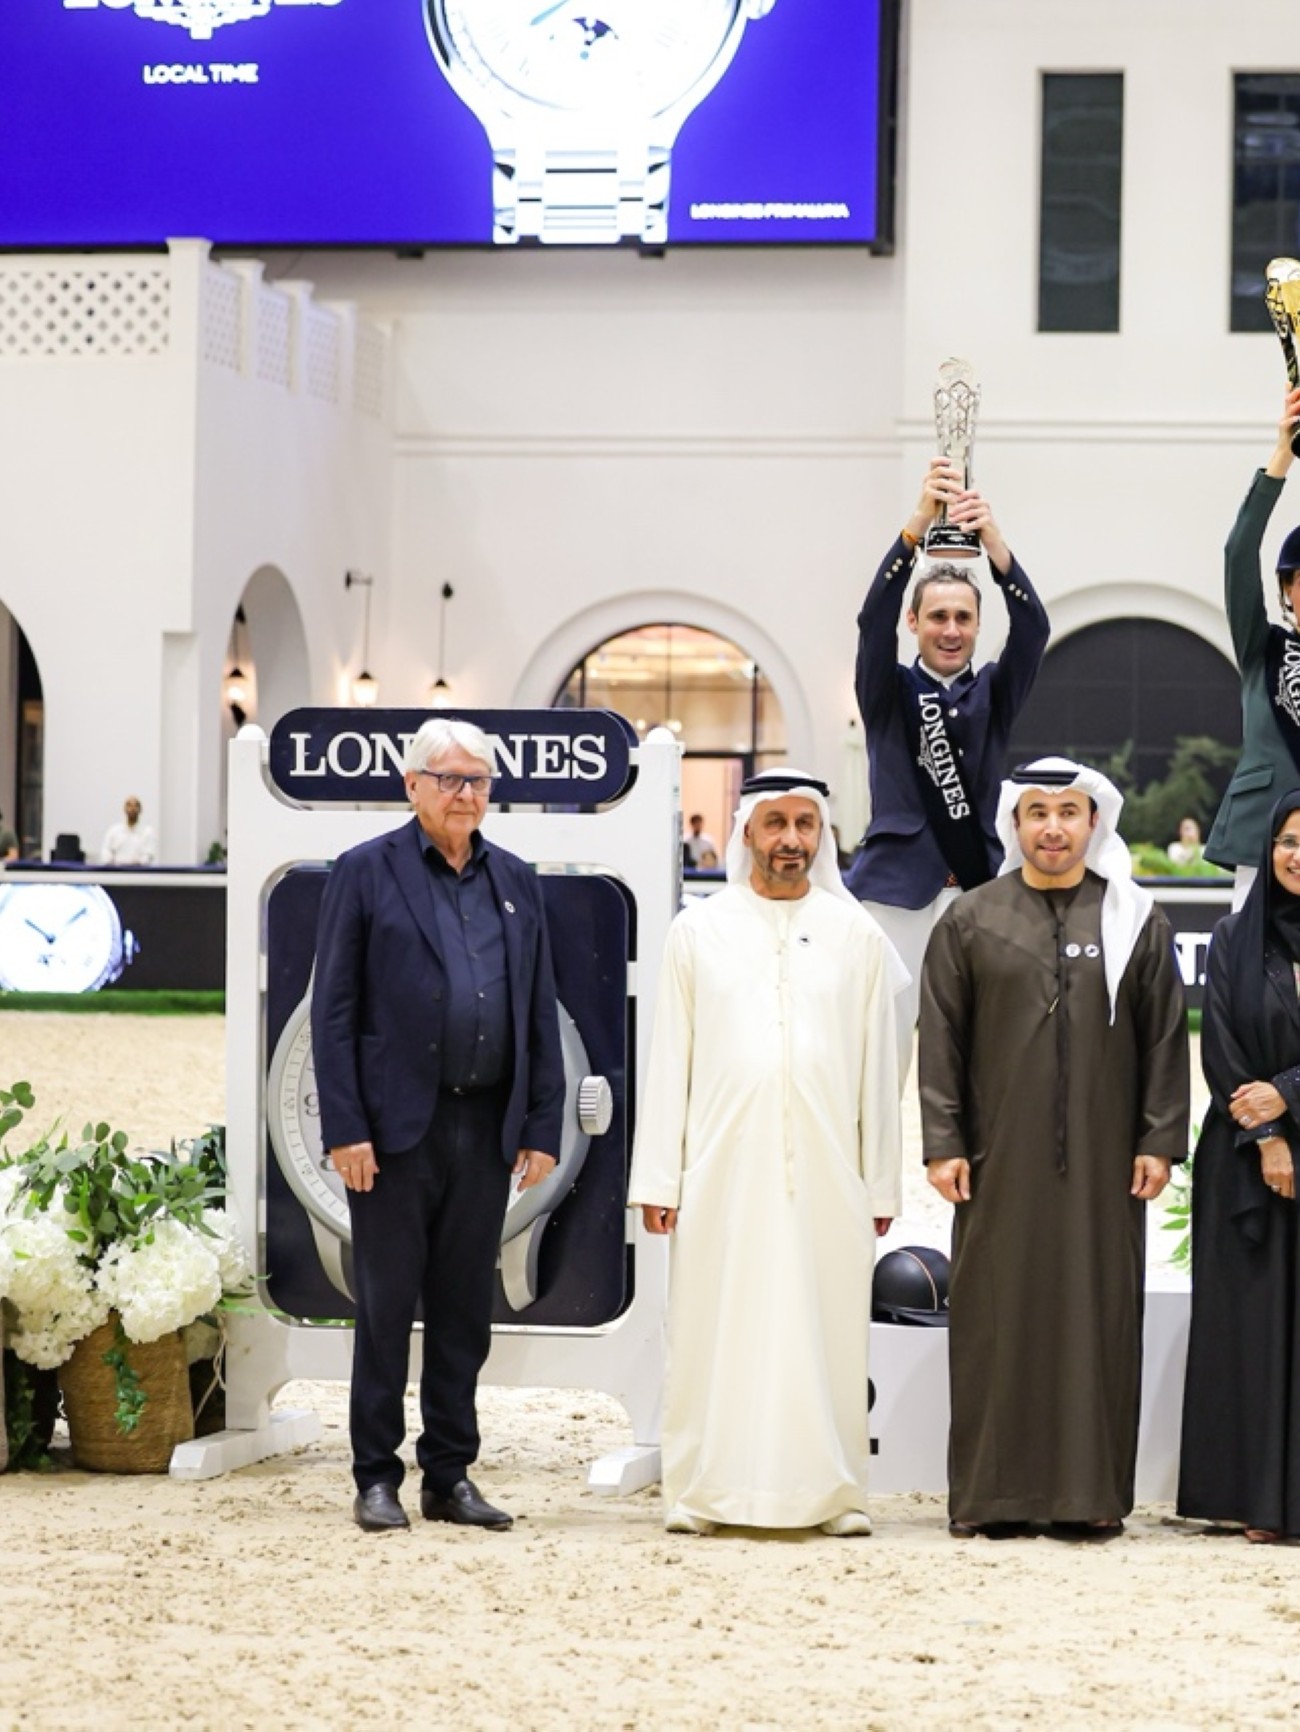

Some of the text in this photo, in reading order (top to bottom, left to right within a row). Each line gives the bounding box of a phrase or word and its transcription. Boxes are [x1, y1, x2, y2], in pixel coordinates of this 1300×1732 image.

[143, 63, 259, 84] LOCAL TIME
[289, 731, 608, 780] LONNES
[918, 692, 970, 820] LONGINES
